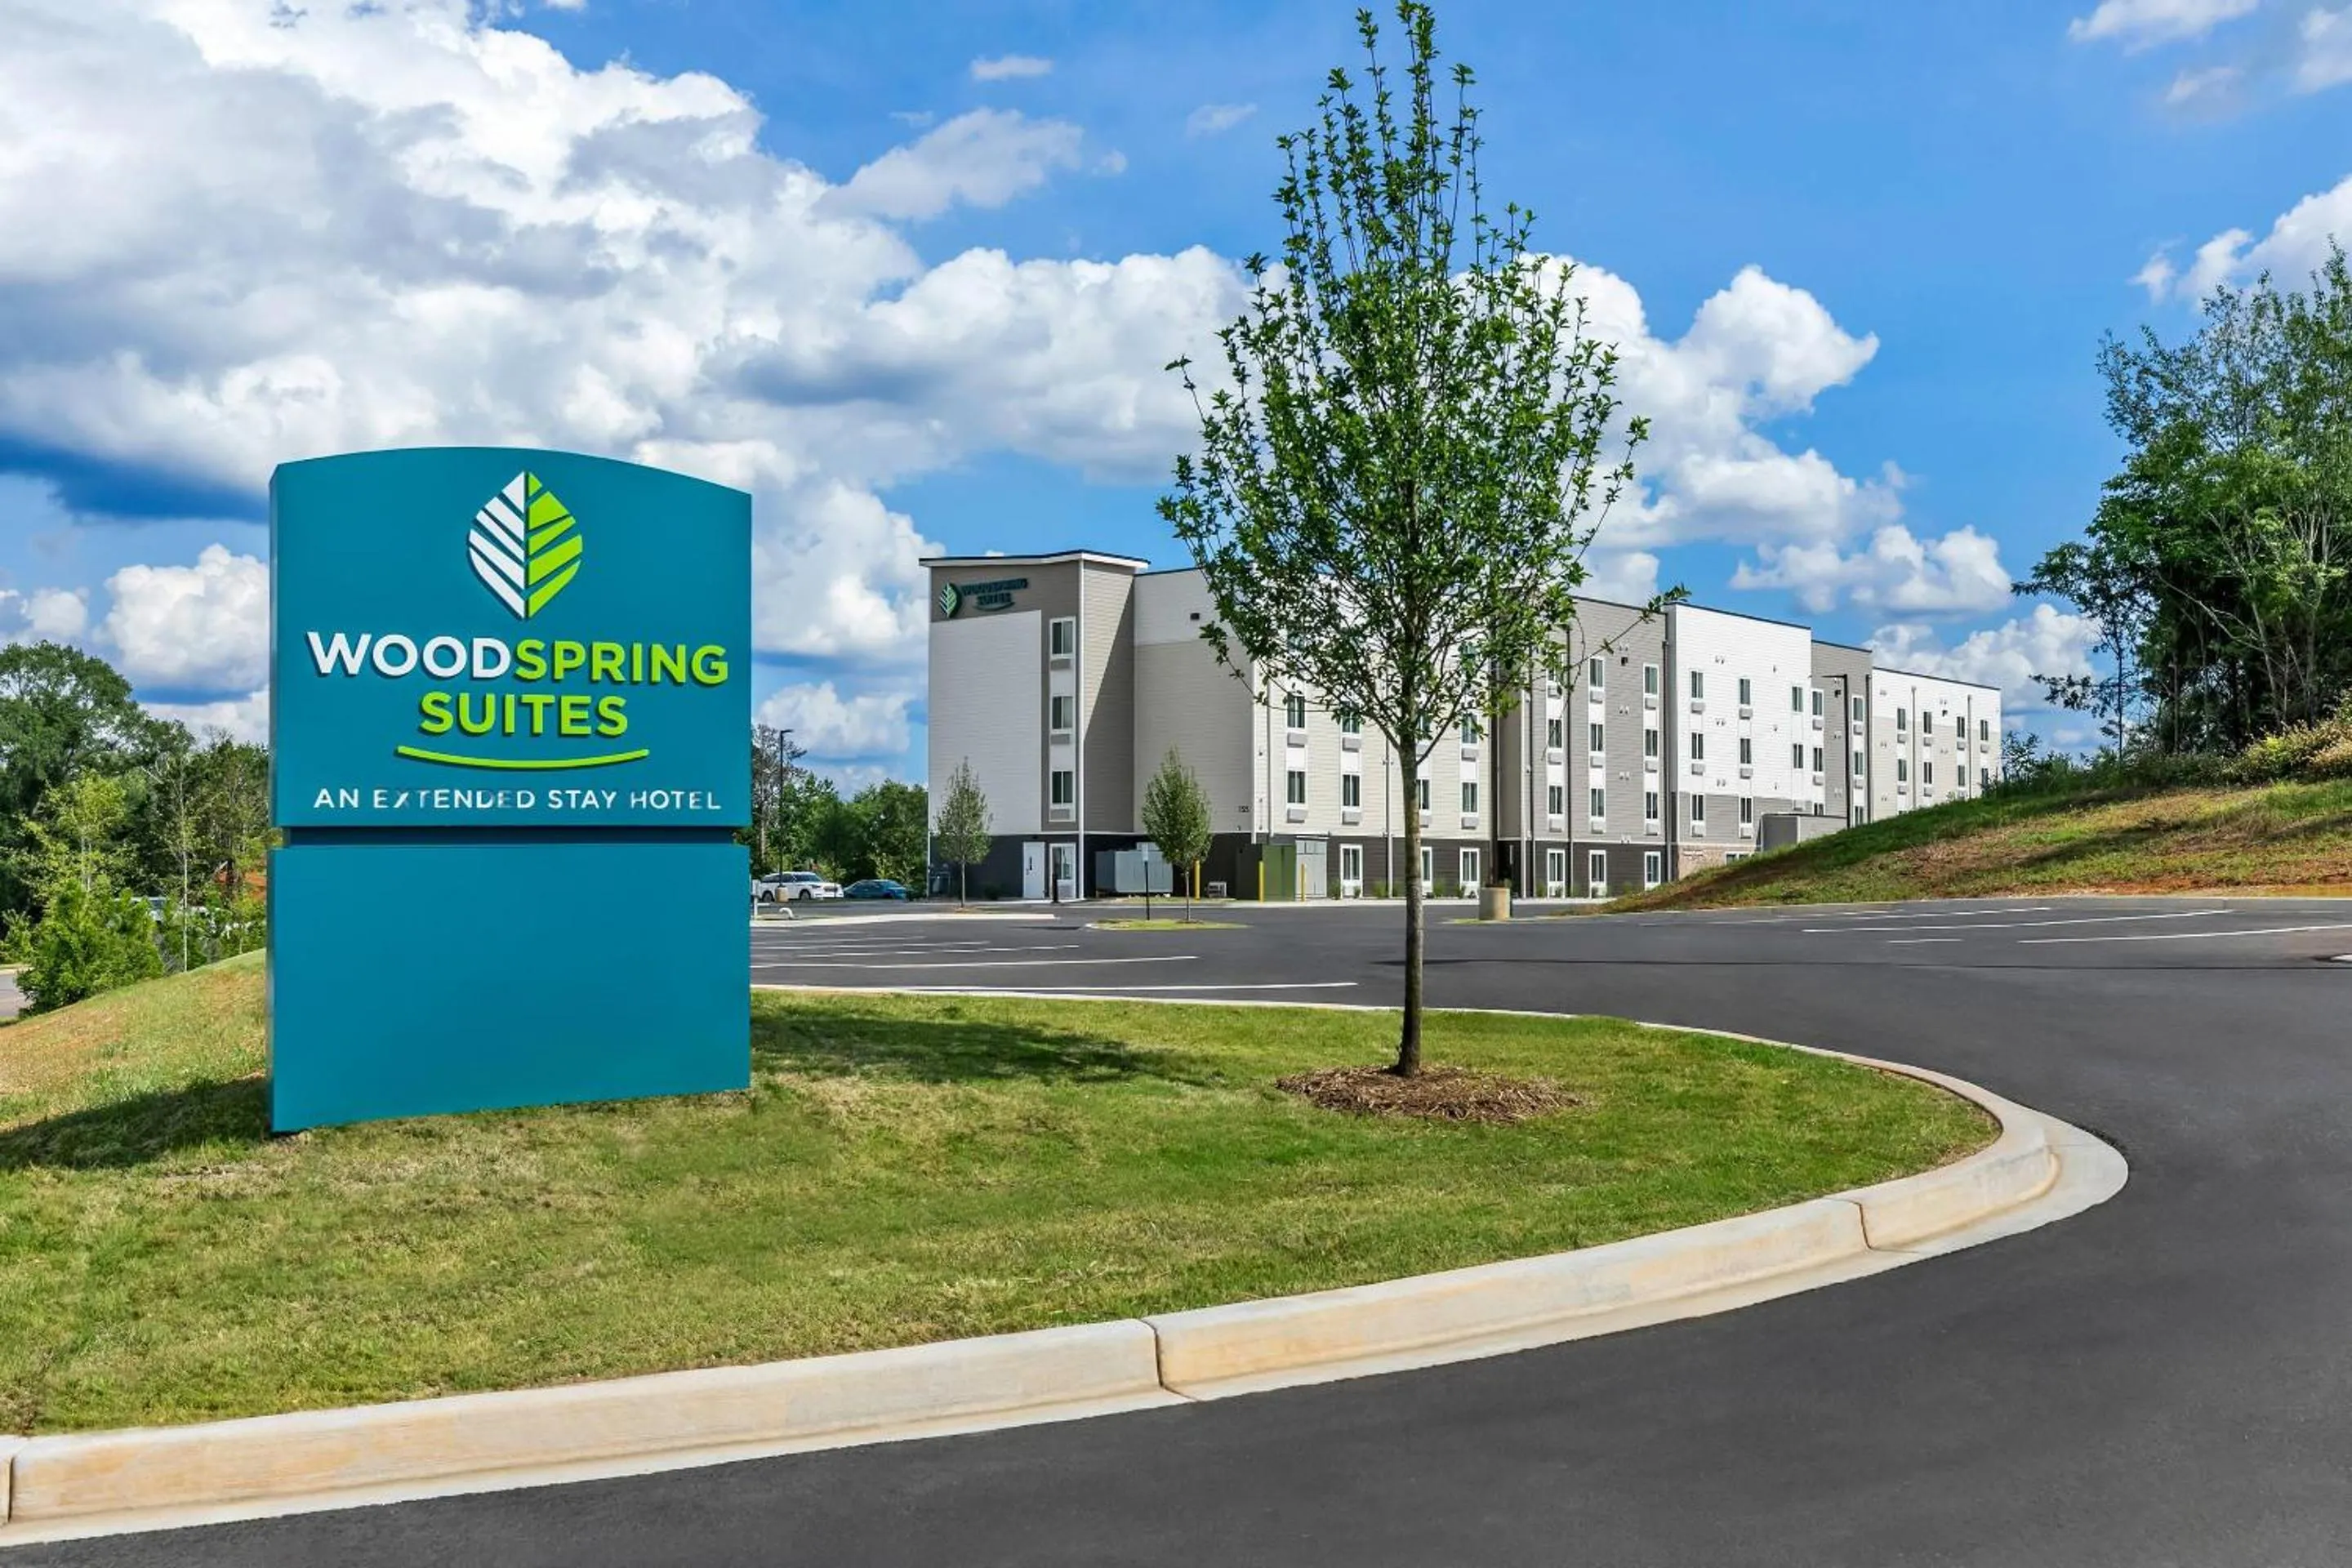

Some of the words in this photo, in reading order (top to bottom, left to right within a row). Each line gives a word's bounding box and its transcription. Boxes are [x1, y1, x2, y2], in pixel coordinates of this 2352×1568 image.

[306, 631, 728, 684] WOODSPRING
[421, 691, 628, 736] SUITES
[314, 788, 359, 808] AN
[373, 789, 536, 808] EXTENDED
[548, 790, 617, 809] STAY
[630, 790, 722, 809] HOTEL
